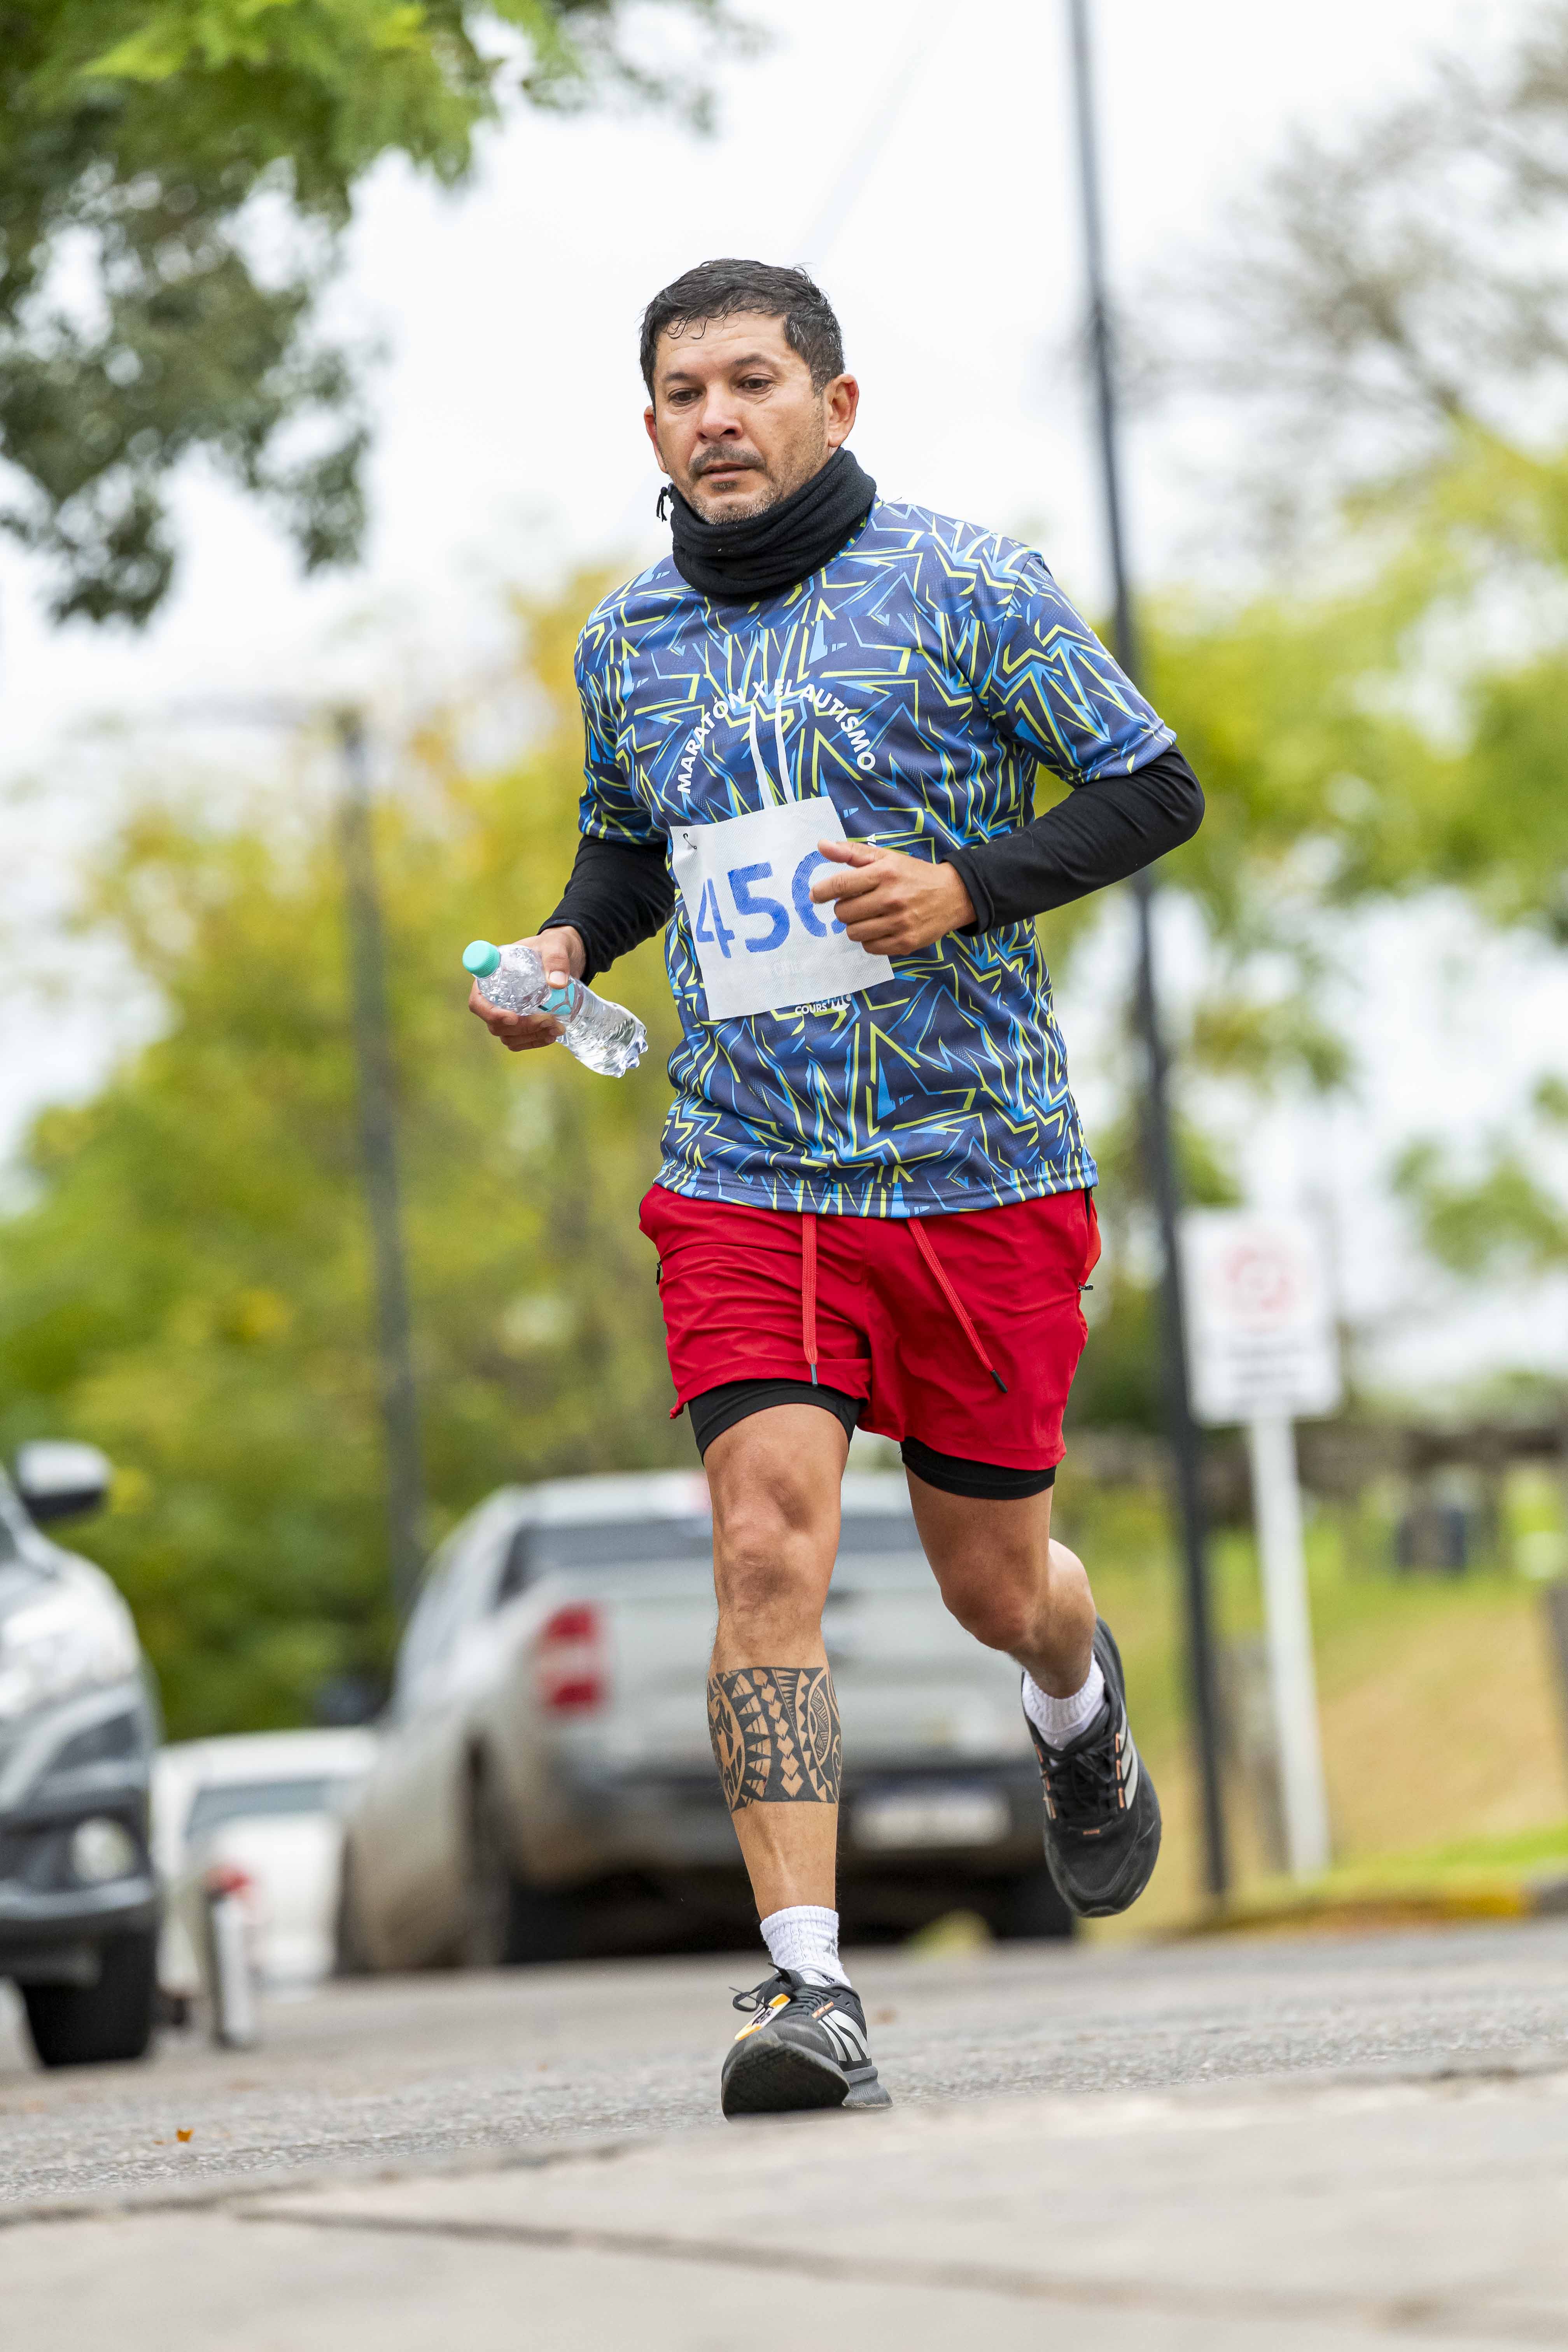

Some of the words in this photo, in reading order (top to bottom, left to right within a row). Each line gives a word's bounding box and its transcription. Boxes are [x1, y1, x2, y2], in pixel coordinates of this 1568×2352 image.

[677, 687, 746, 794] MARATÓN
[752, 680, 767, 700] X
[774, 679, 794, 697] EL
[798, 683, 876, 771] AUTISMO
